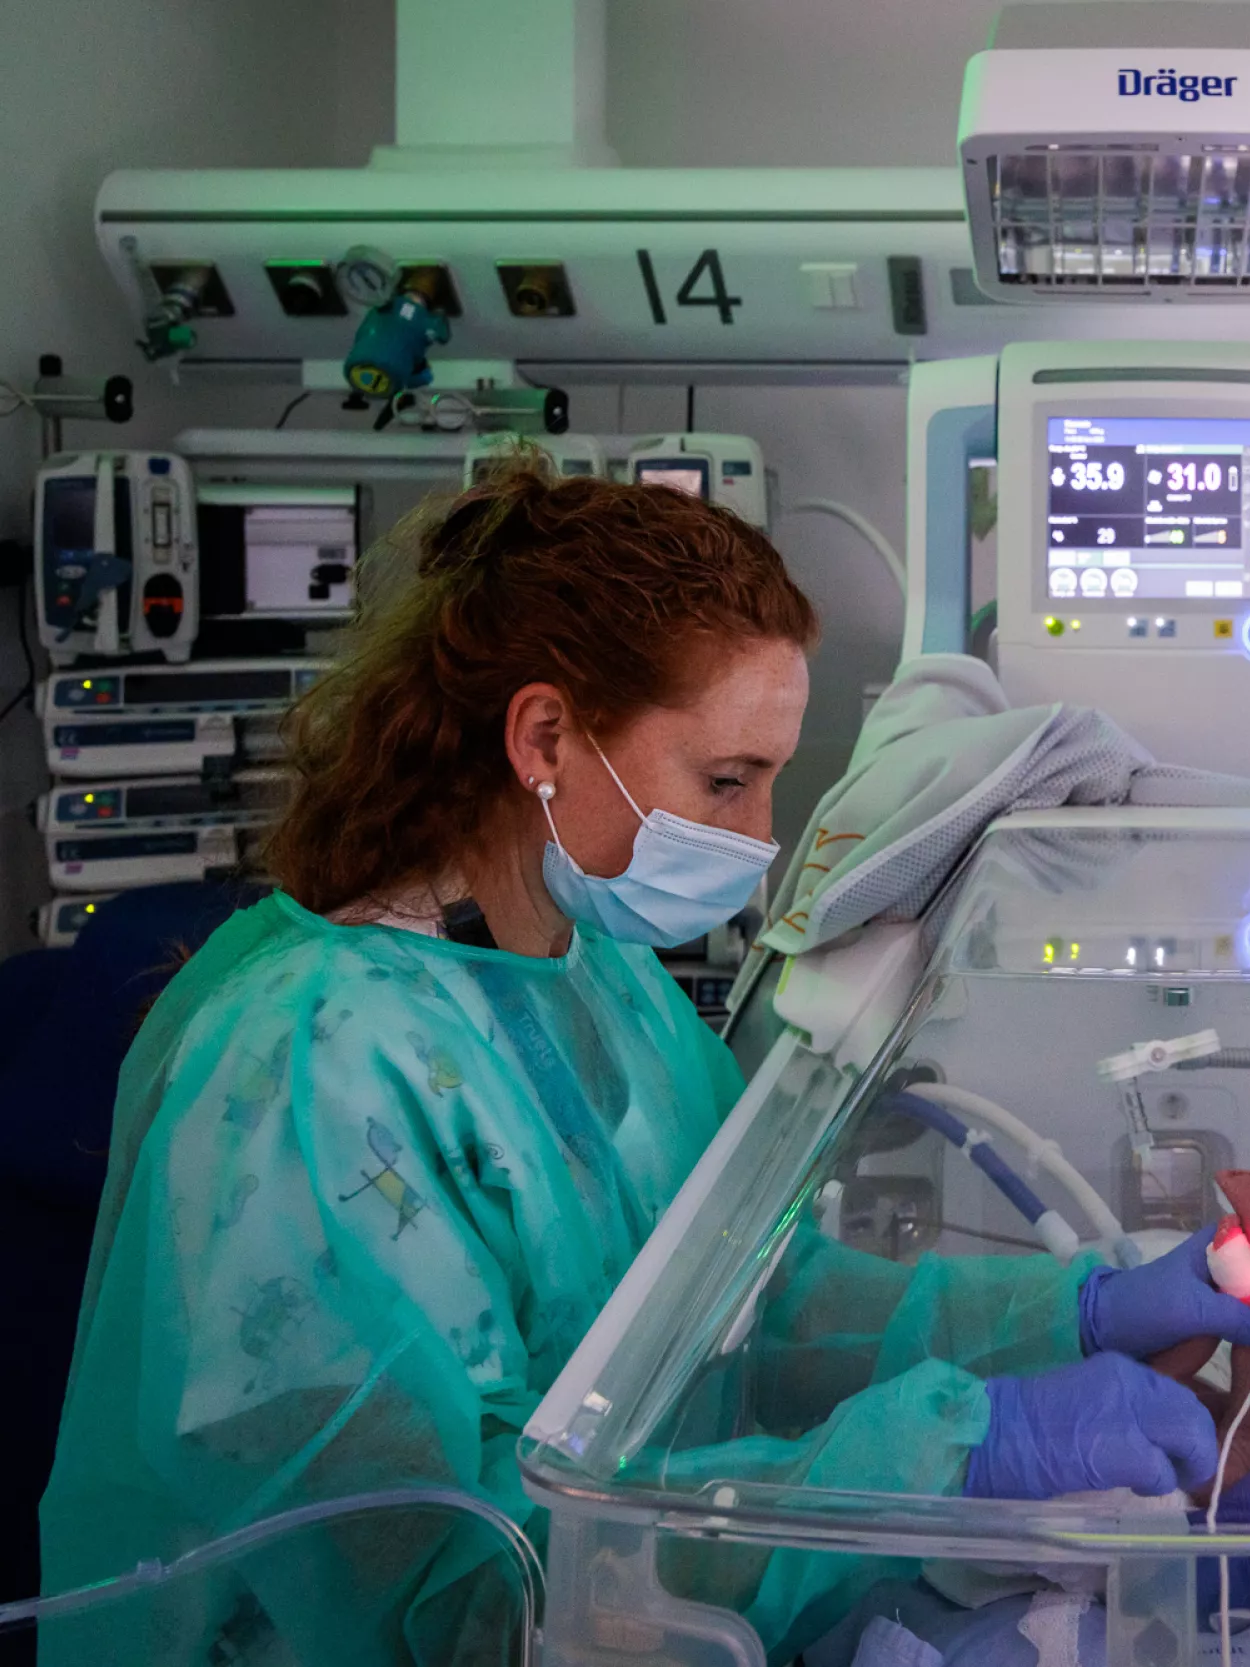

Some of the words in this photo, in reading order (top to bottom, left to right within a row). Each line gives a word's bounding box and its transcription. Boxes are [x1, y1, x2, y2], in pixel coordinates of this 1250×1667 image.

[1118, 68, 1238, 102] Dräger
[636, 248, 743, 325] 14
[1070, 461, 1125, 491] 35.9
[1166, 461, 1222, 491] 31.0
